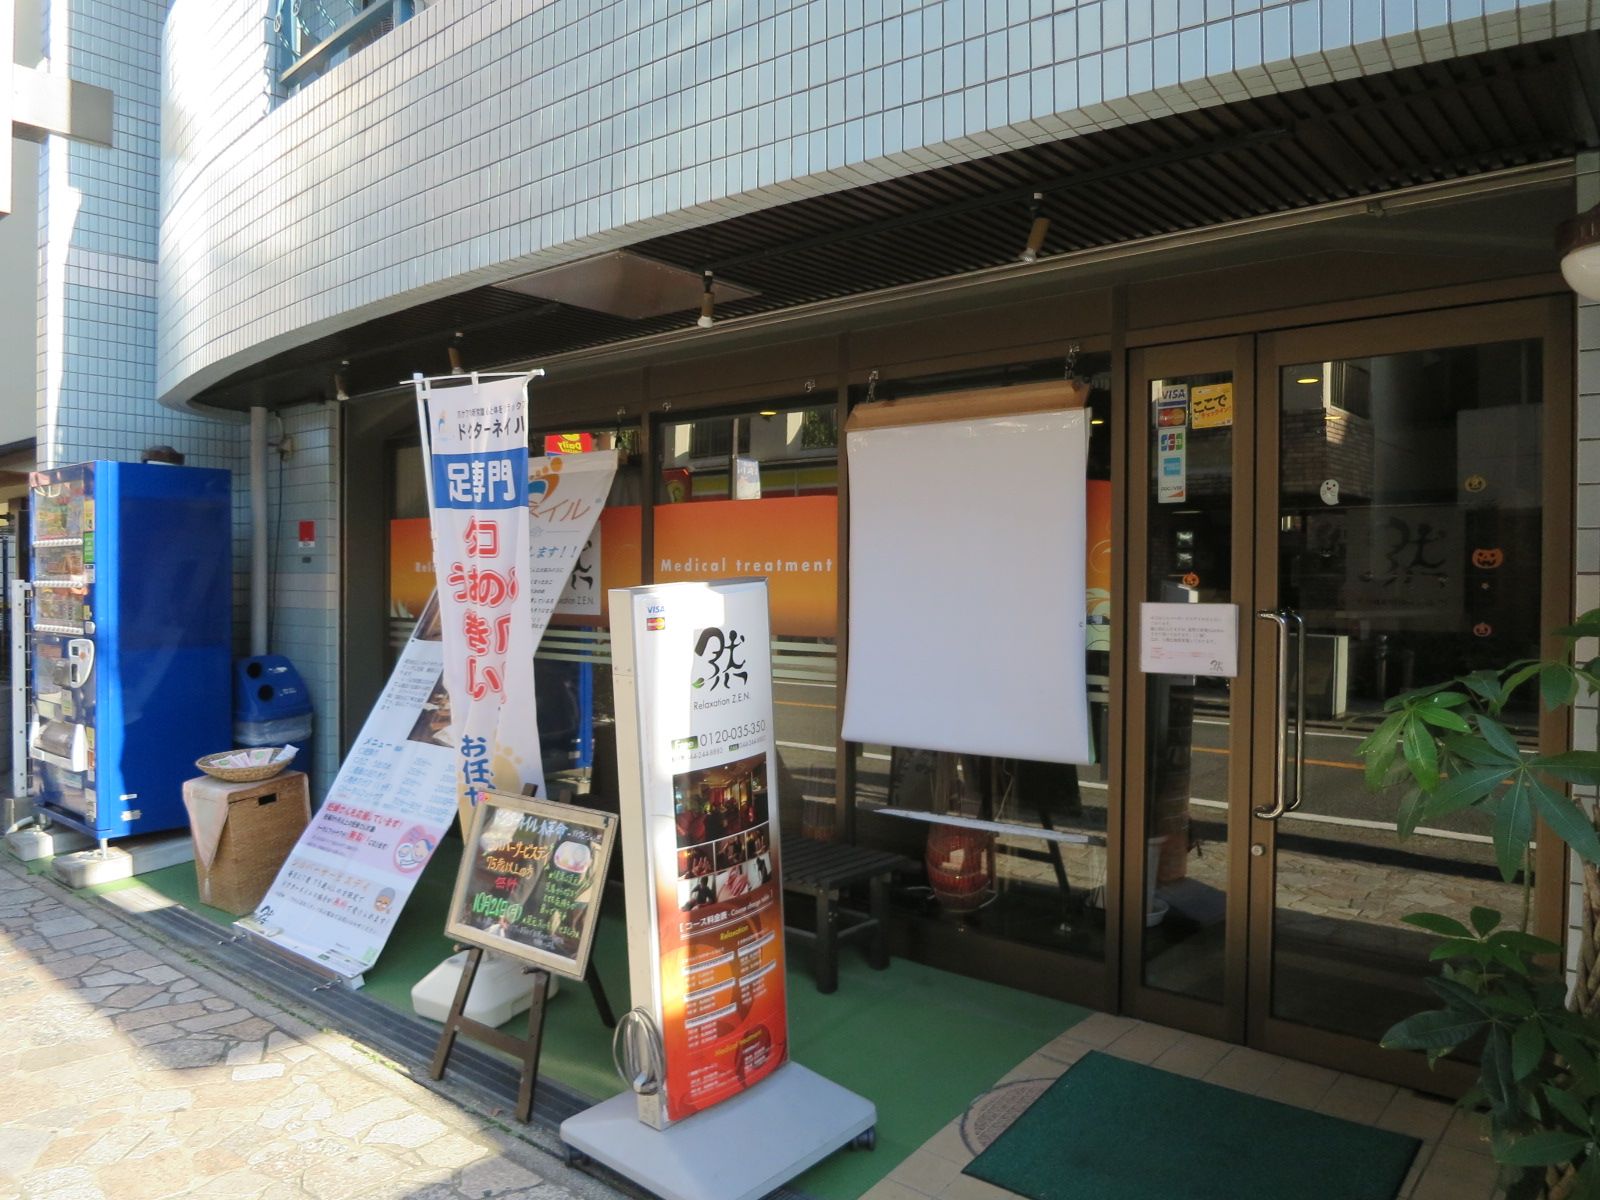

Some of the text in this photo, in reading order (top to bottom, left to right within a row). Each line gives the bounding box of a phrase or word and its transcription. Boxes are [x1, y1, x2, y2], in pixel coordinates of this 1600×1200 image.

[1162, 388, 1186, 400] VISA
[1193, 393, 1228, 414] ここで
[447, 458, 516, 503] 足専門
[660, 558, 832, 572] Medical treatment
[647, 604, 665, 614] VISA
[693, 698, 731, 711] Relaxation
[699, 719, 767, 747] 0120-035-350
